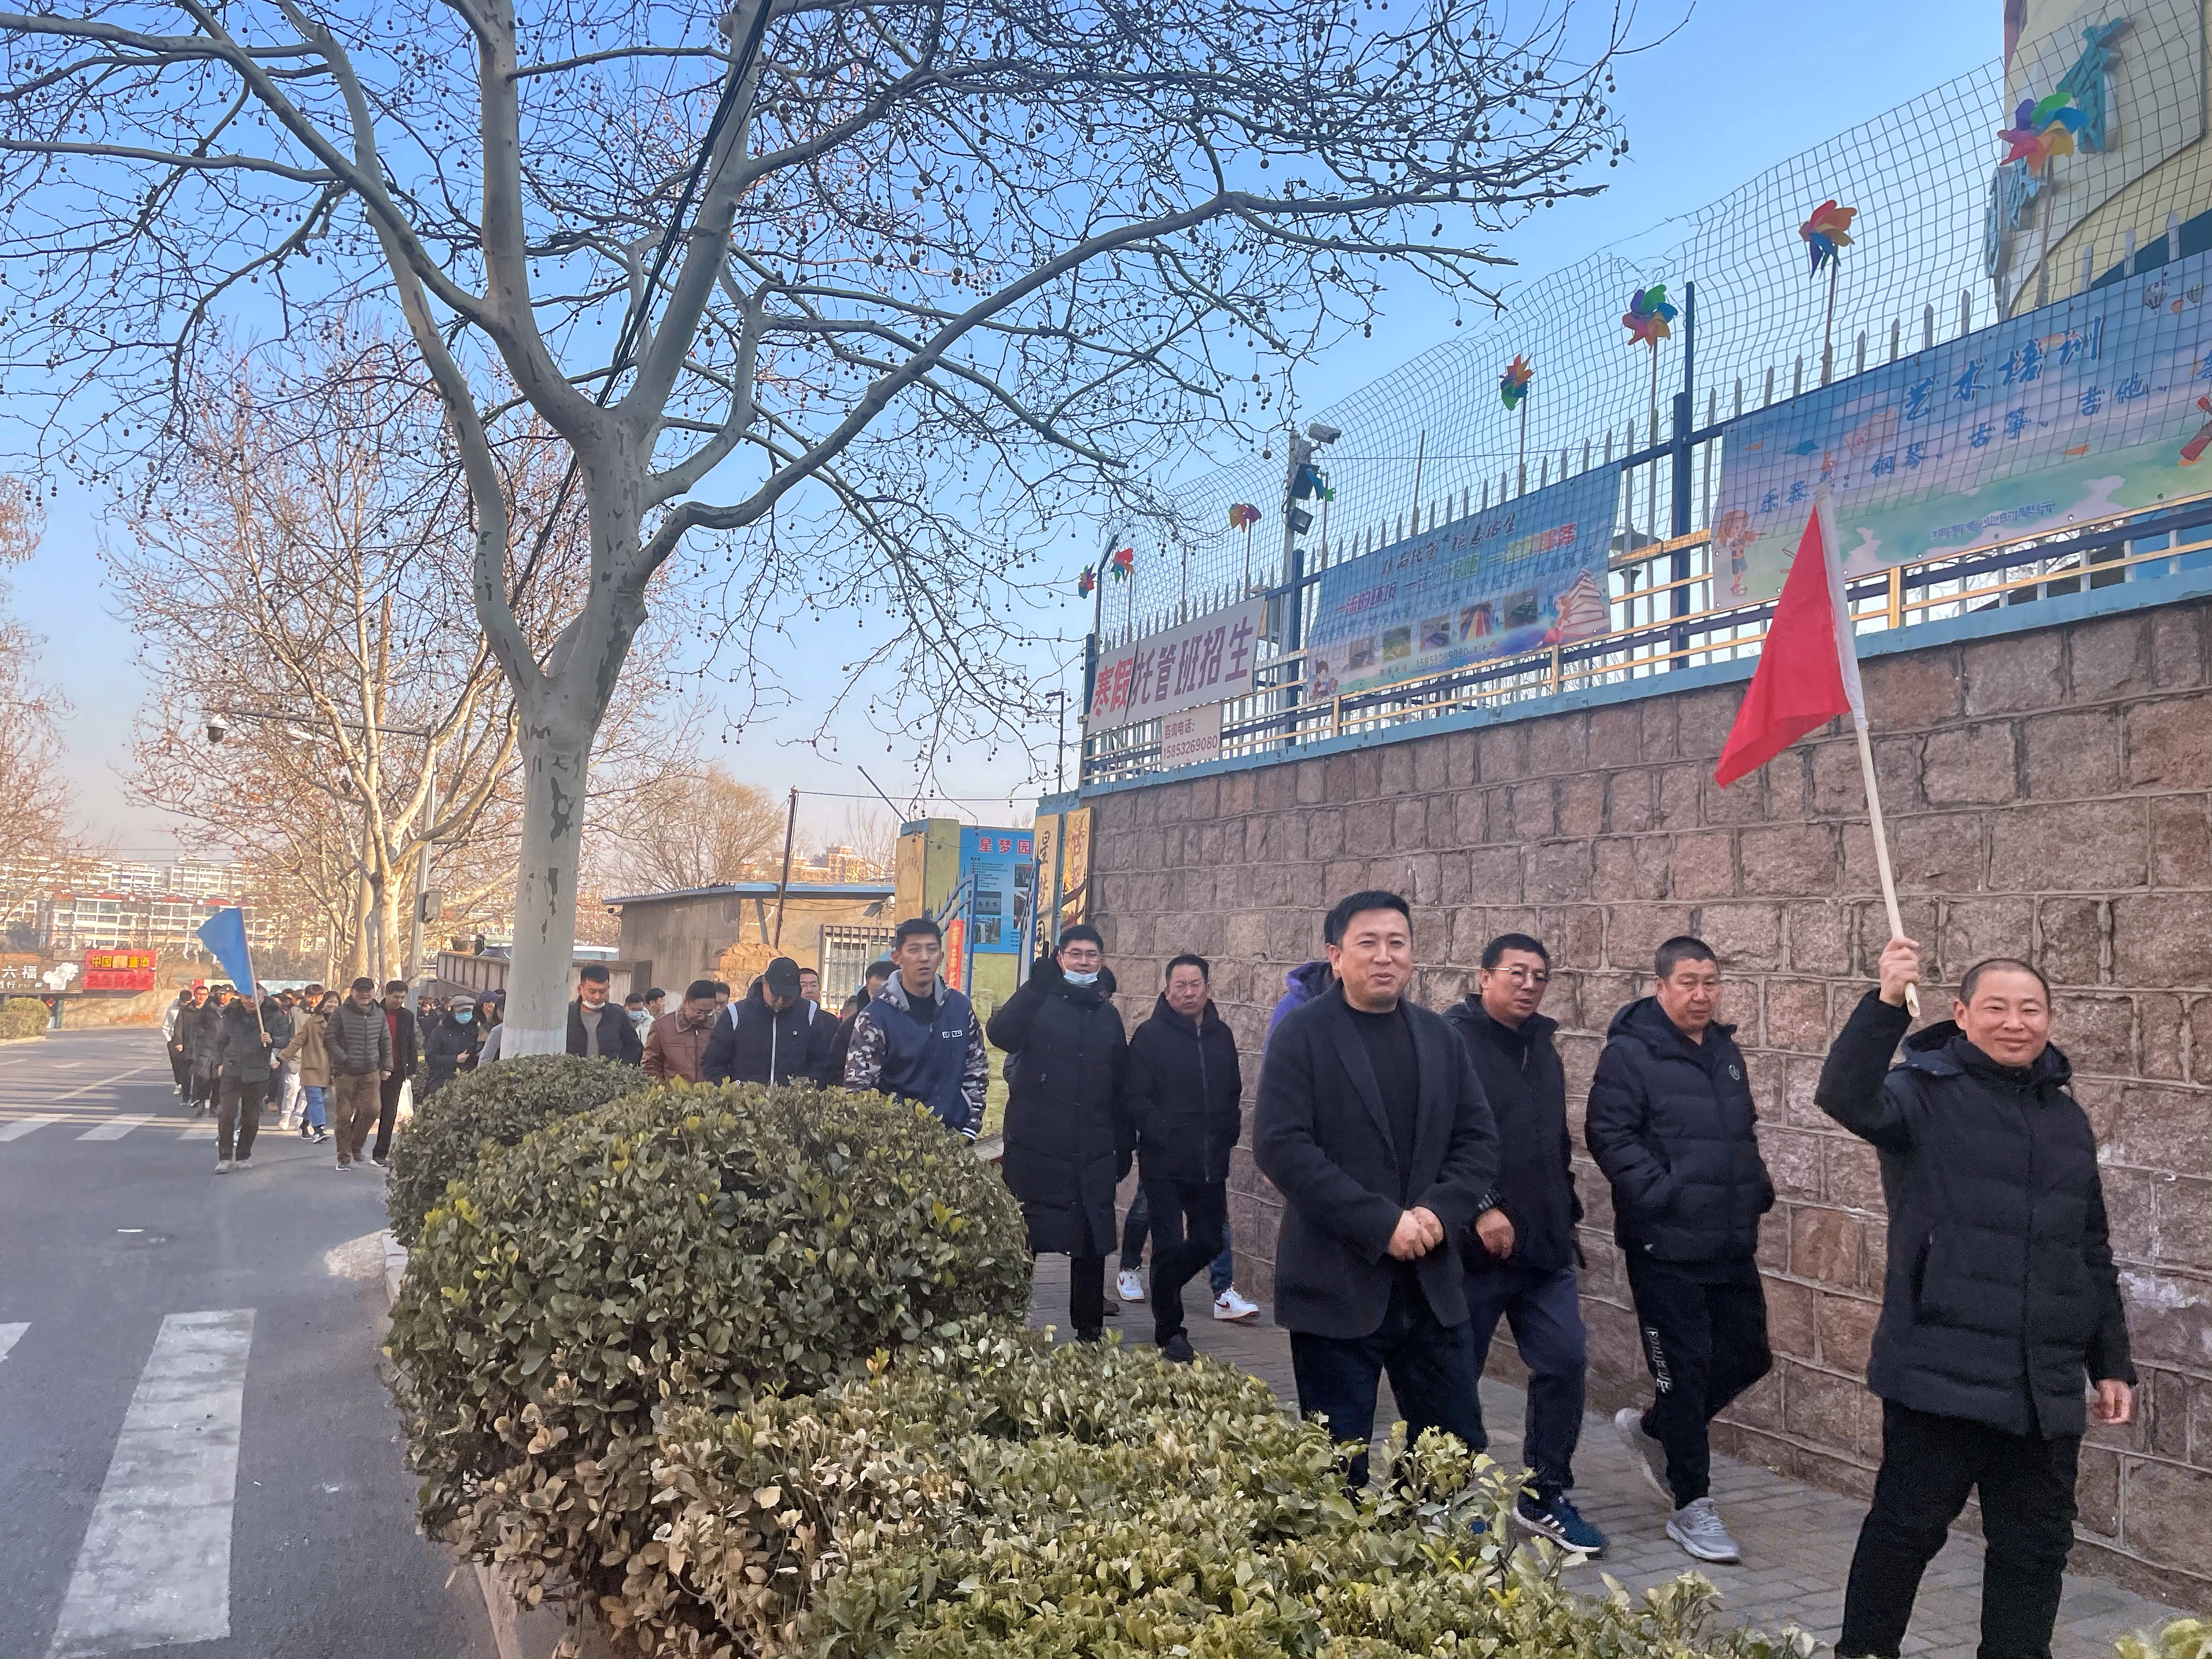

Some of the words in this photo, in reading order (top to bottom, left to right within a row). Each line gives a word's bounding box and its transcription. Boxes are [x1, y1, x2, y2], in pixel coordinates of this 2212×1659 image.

[1905, 315, 2105, 421] 艺术培训
[1335, 582, 1398, 614] 一流的环境
[1404, 553, 1481, 592] 一流的设施
[1488, 522, 1577, 563] 一流的服务
[1092, 616, 1255, 718] 寒假托管班招生
[1416, 647, 1469, 668] 15853269080
[1163, 718, 1196, 741] 咨询电话：
[1163, 735, 1218, 760] 15853269080
[979, 837, 1031, 855] 星梦园
[1, 965, 38, 979] 六福
[92, 955, 112, 968] 中国
